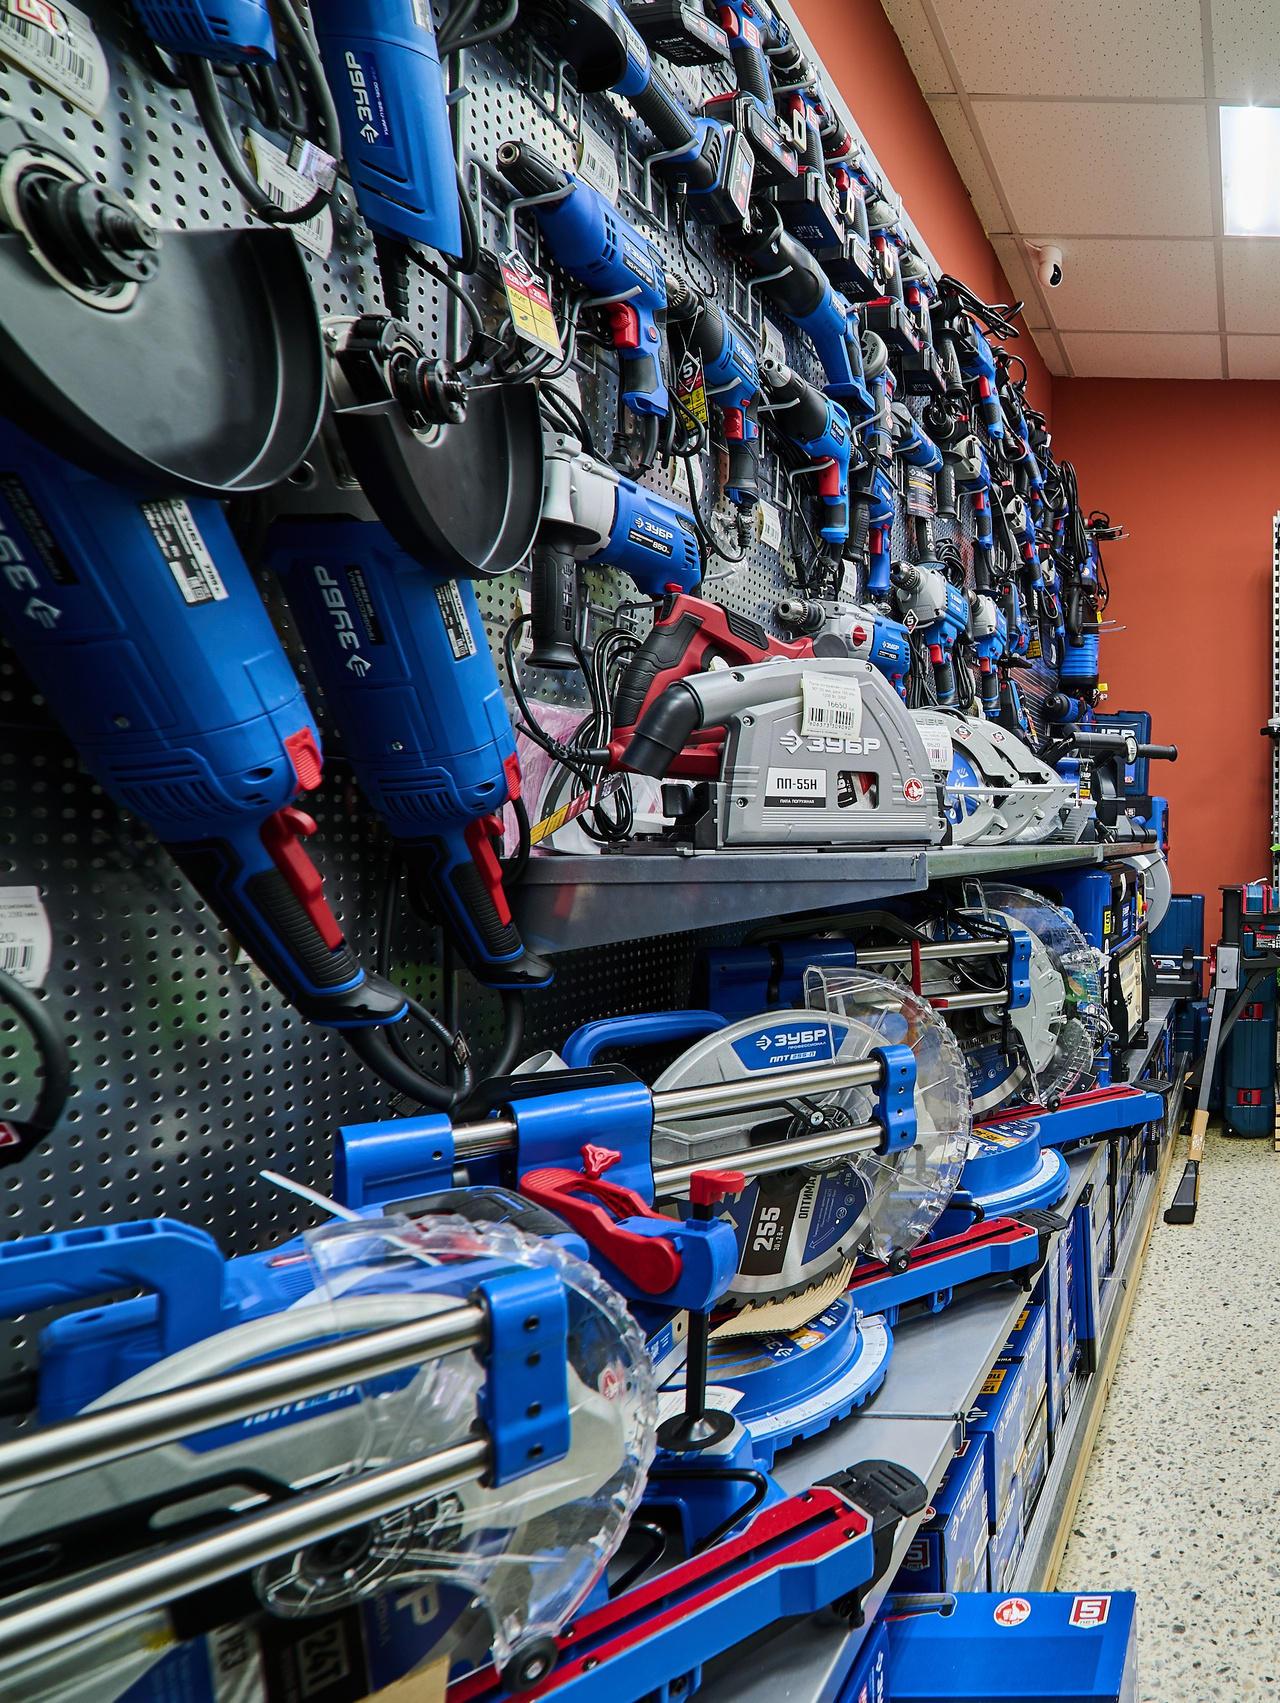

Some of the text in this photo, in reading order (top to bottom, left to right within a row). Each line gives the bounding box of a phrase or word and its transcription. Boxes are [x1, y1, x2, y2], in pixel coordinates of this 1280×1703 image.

[345, 51, 374, 122] ЗУБР
[683, 362, 693, 379] 5
[644, 521, 674, 540] ЗУБР
[652, 541, 668, 553] 850
[314, 565, 361, 649] ЗУБР
[907, 616, 914, 625] 5
[827, 700, 847, 710] 16650
[807, 735, 881, 755] ЗУБР
[776, 777, 817, 790] ПП-55Н
[774, 1029, 827, 1046] ЗУБР
[788, 1041, 827, 1050] ПРОФЕССИОНАЛ
[770, 1055, 790, 1063] ППТ
[753, 1206, 782, 1252] 255
[960, 1456, 985, 1522] ЗУБР
[1079, 1601, 1101, 1619] 5
